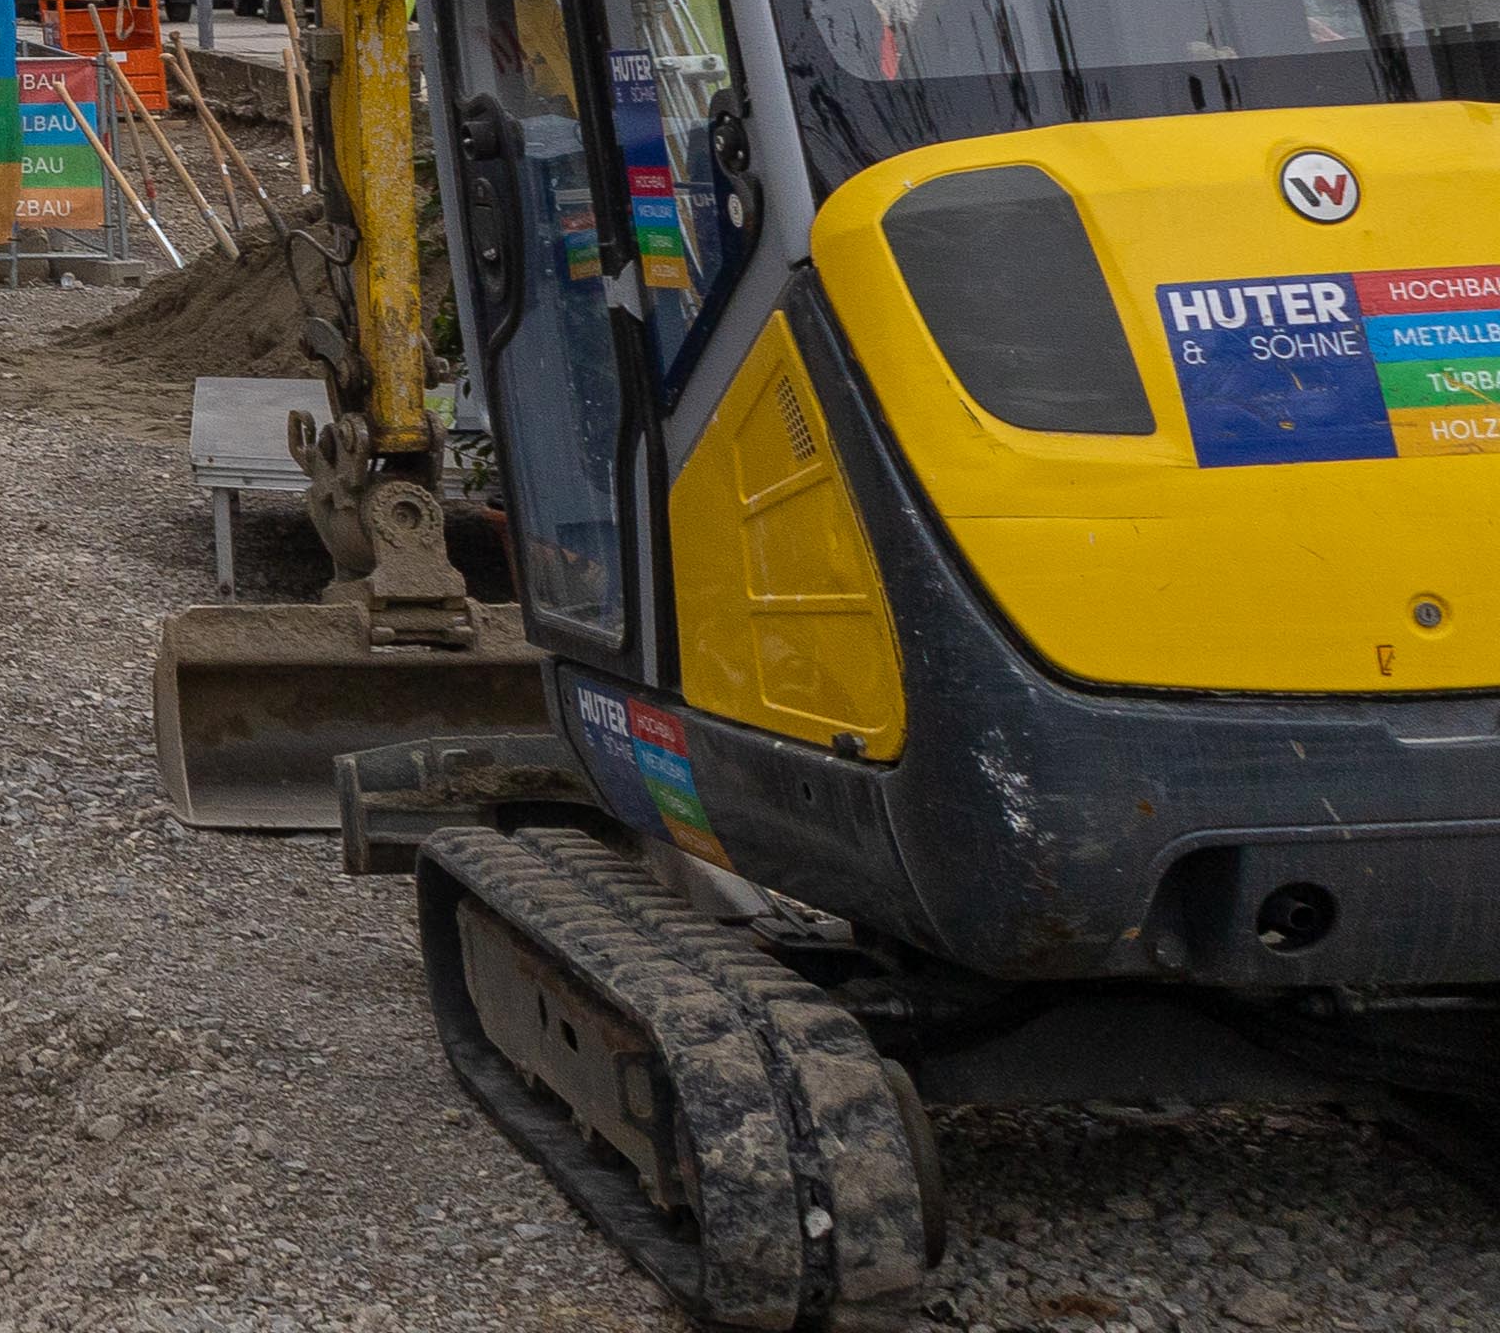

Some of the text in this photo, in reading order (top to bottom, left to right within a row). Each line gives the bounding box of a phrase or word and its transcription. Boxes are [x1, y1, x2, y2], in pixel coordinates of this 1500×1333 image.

[610, 54, 653, 82] HUTER
[20, 156, 64, 174] BAU
[15, 200, 71, 217] ZBAU
[1388, 276, 1500, 301] HOCHBA
[1168, 282, 1350, 332] HUTER
[1182, 328, 1363, 365] & SÖHNE
[577, 687, 629, 737] HUTER
